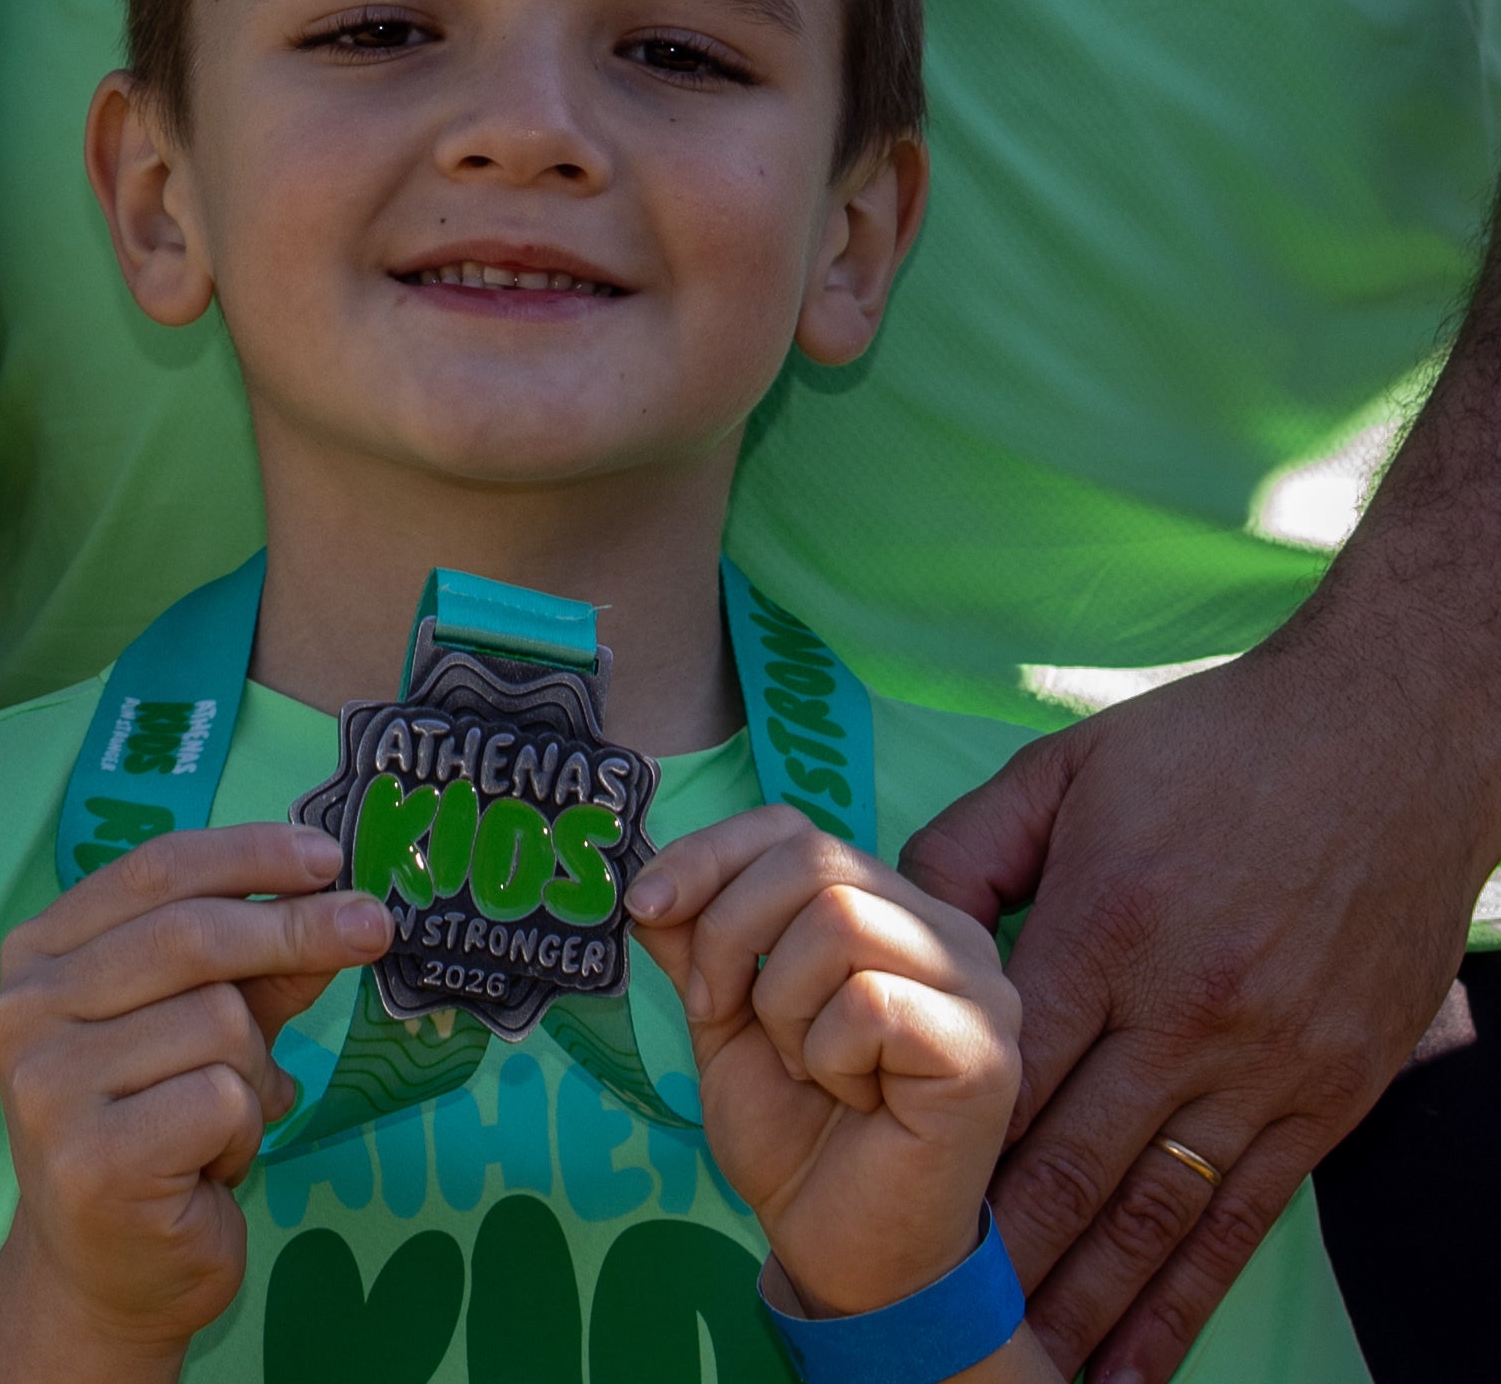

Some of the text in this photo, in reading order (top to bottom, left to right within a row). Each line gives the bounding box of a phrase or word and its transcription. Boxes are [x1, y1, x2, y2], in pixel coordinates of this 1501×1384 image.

[123, 701, 197, 775] KIDS
[171, 699, 217, 775] ATHENAS
[375, 717, 630, 813] ATHENAS
[351, 772, 623, 927] KIDS
[422, 911, 607, 978] STRONGER
[422, 961, 506, 997] 2026
